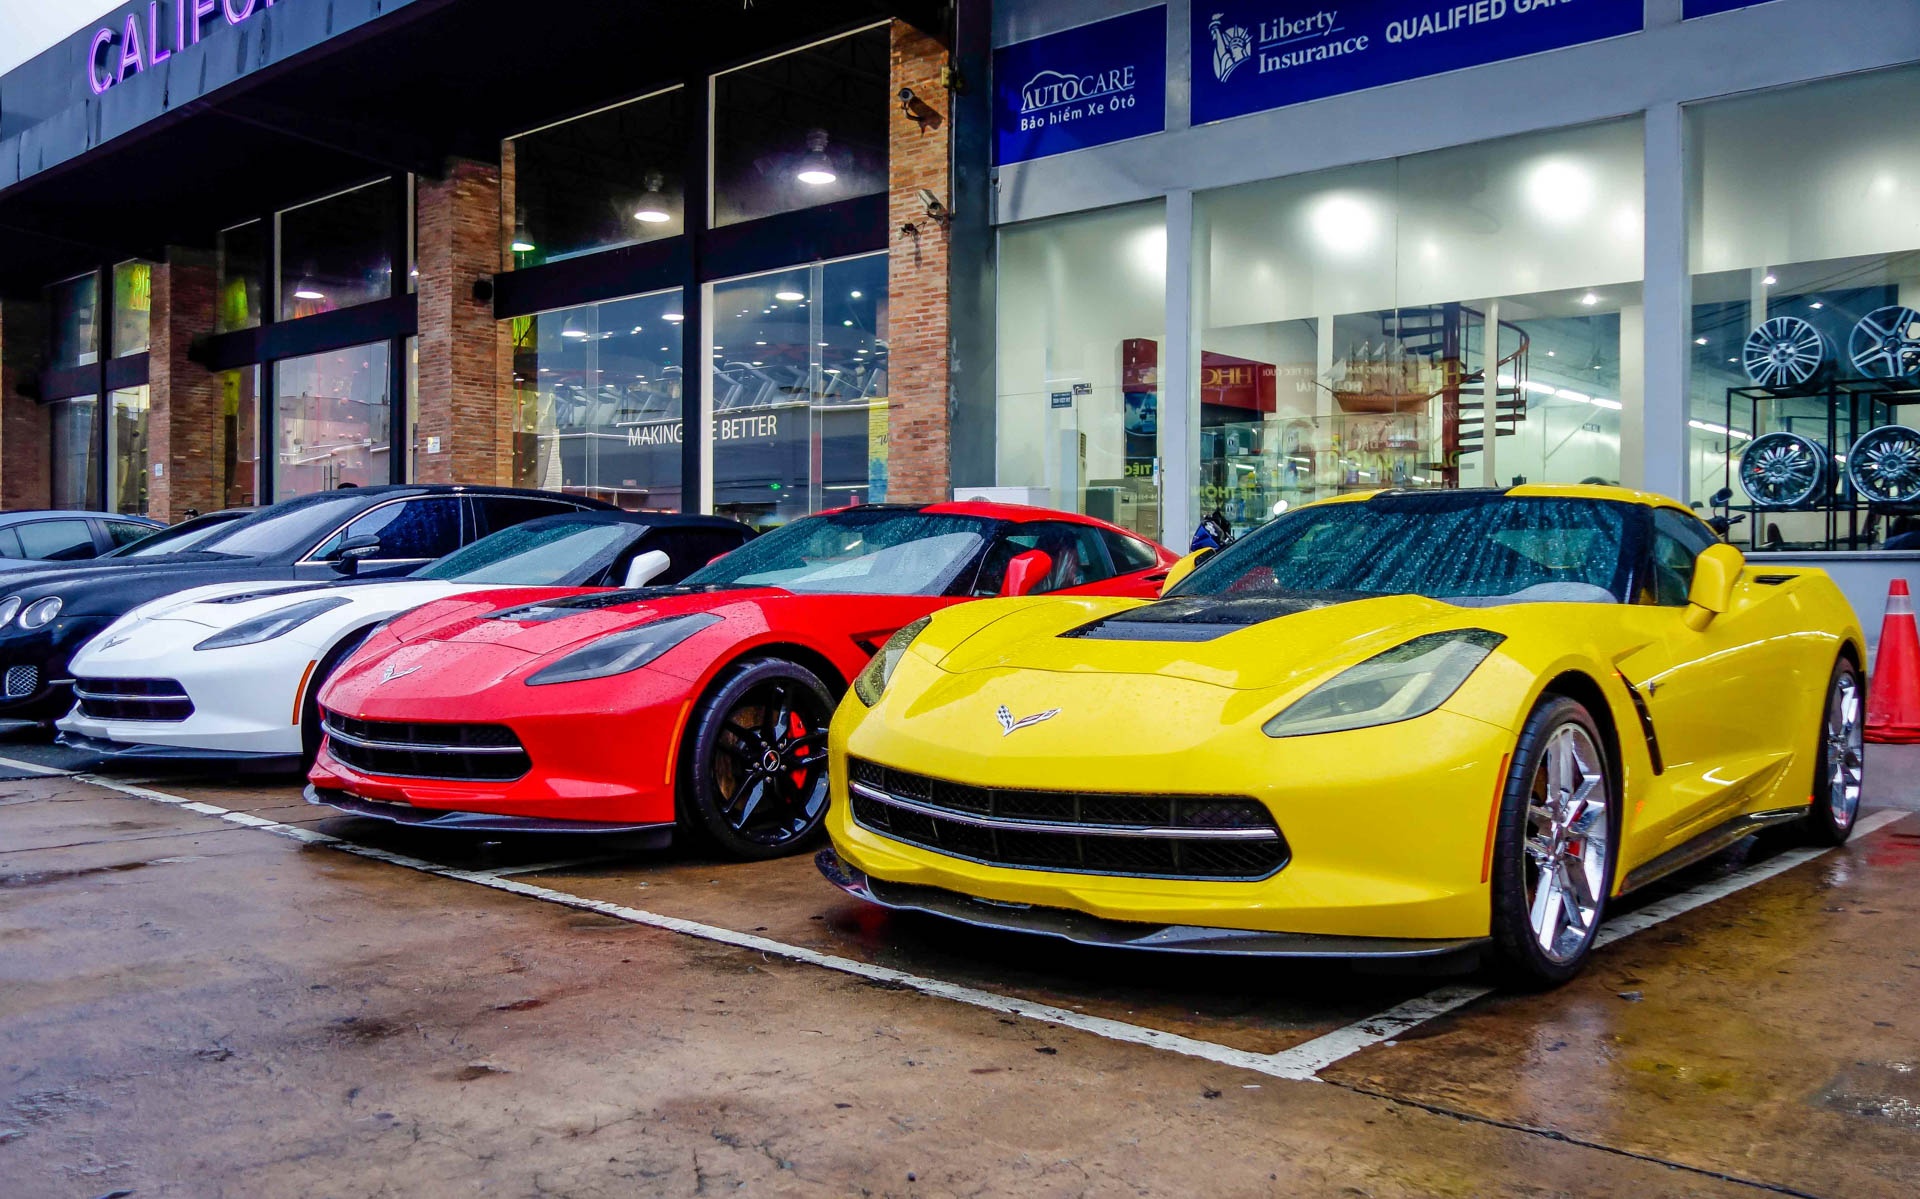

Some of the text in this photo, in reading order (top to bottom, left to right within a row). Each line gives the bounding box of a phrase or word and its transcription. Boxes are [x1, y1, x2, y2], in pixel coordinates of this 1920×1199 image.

[1259, 10, 1337, 43] Liberty
[1385, 0, 1506, 43] QUALIFIED
[88, 0, 273, 94] CALIF
[1259, 35, 1369, 74] Insurance
[1021, 65, 1136, 111] AUTOCARE
[1021, 94, 1136, 131] Bảo hiểm Xe Ôtô
[722, 414, 777, 440] BETTER
